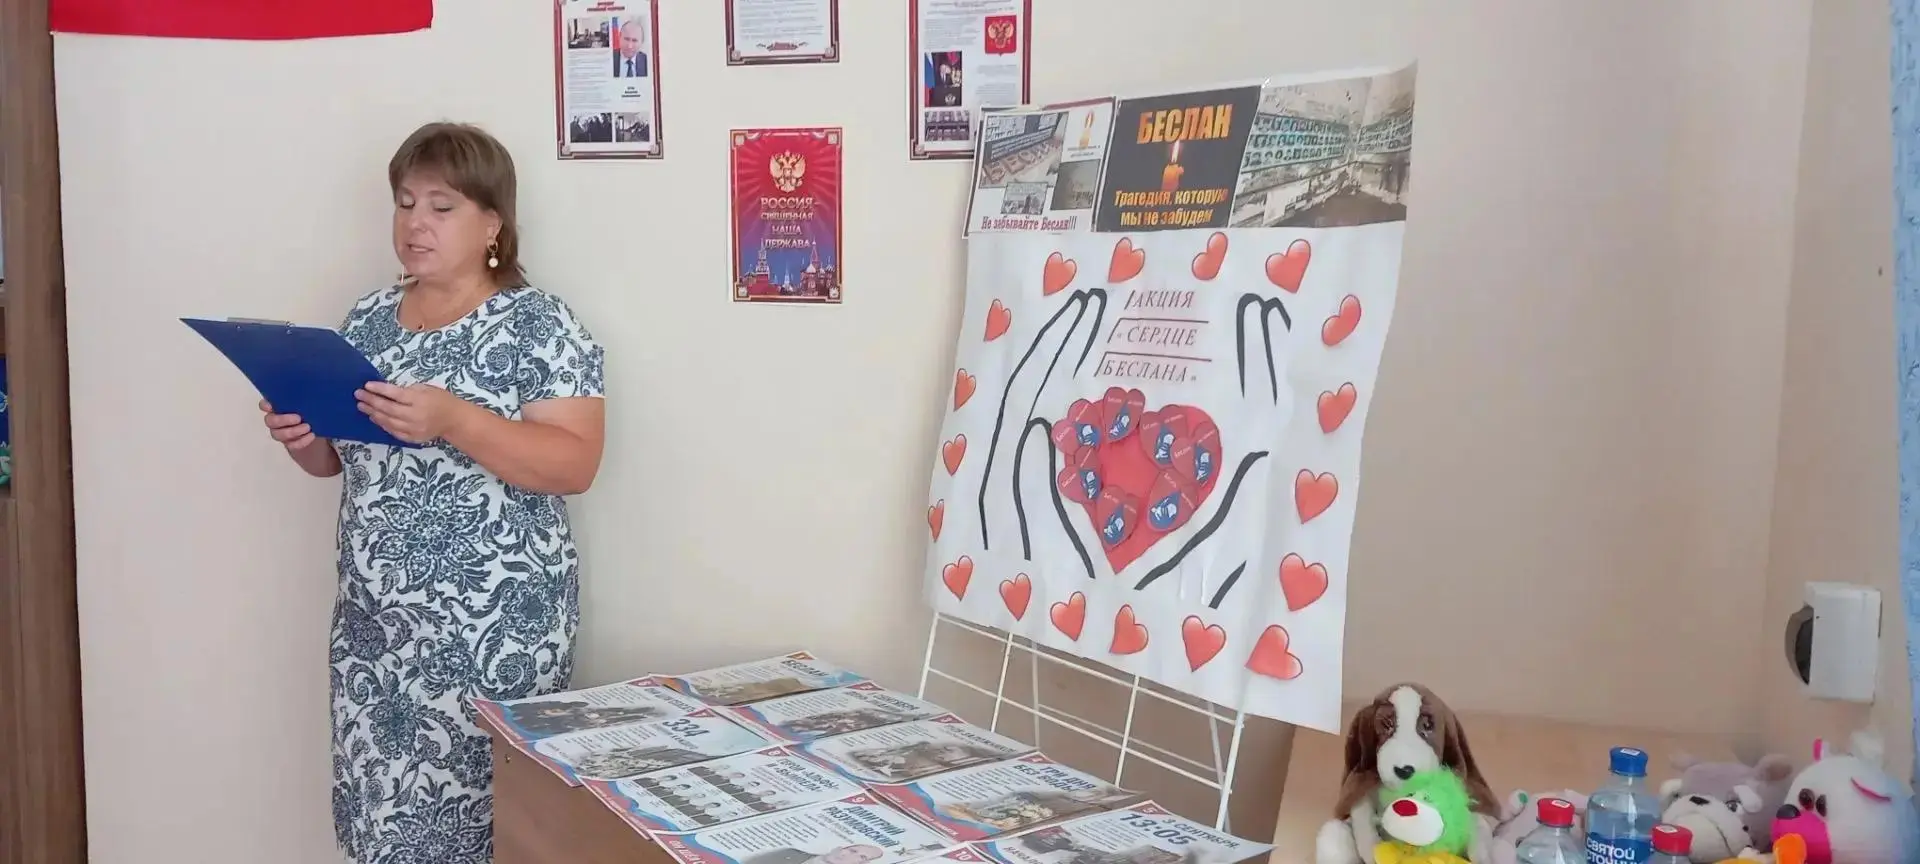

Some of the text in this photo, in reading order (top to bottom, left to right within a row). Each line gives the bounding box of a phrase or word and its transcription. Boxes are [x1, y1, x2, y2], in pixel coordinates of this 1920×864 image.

[1137, 104, 1233, 144] БЕСЛАН
[760, 197, 813, 209] РОССИЯ
[1174, 188, 1229, 206] которую
[1143, 211, 1159, 226] не
[1160, 208, 1214, 228] забудем
[765, 239, 810, 249] ДЕРЖАВА
[1132, 290, 1195, 309] АКЦИЯ
[662, 719, 710, 738] 334
[1013, 764, 1039, 777] БЕЗ
[1036, 774, 1081, 793] ВОДЫ
[1039, 766, 1097, 790] ТРИ ДНЯ
[821, 806, 901, 848] РАЗУМОВСКИЙ
[843, 806, 905, 836] ДМИТРИЙ
[1119, 813, 1198, 846] 13:05
[955, 851, 972, 861] 10
[1586, 837, 1636, 860] СВЯТОЙ
